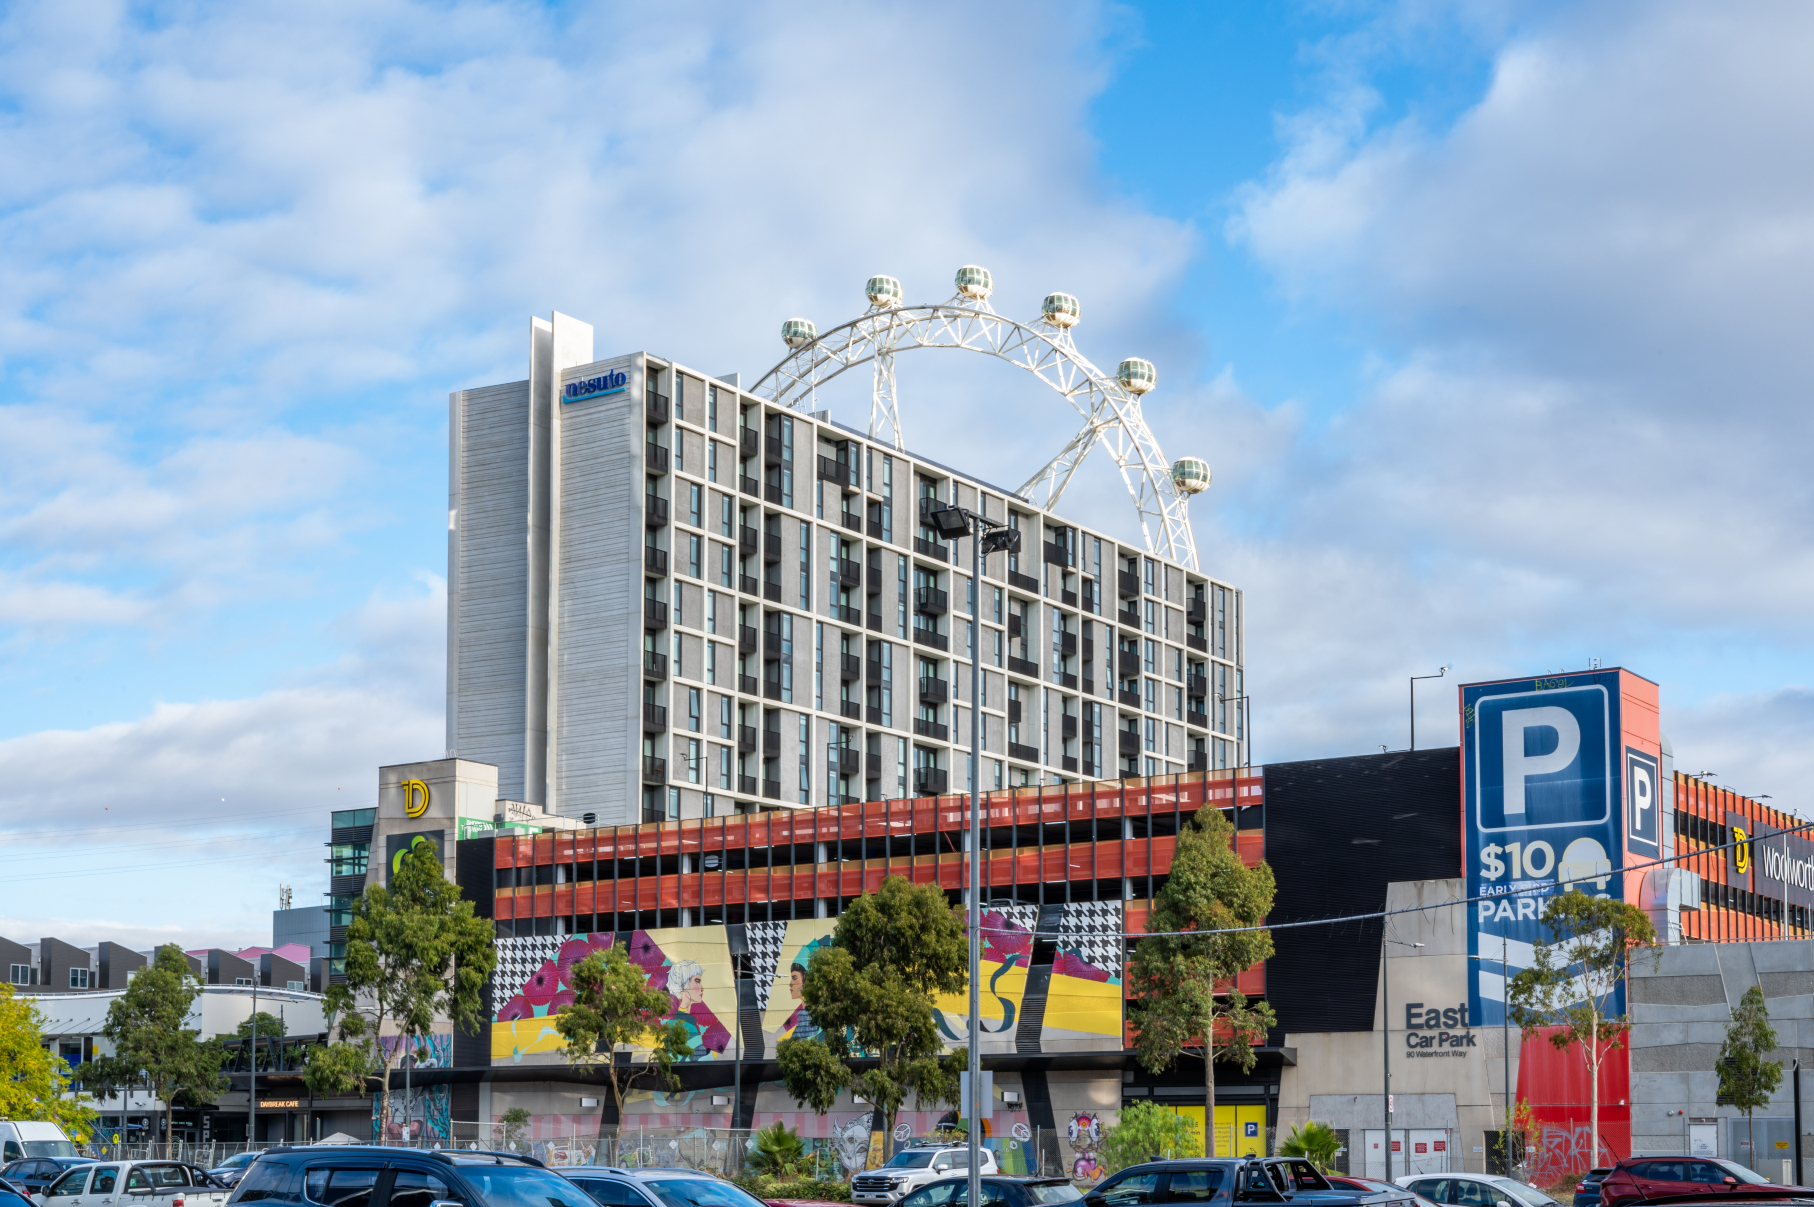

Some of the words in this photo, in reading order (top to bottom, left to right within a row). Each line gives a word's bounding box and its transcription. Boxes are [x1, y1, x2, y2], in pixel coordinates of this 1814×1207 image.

[565, 368, 627, 397] nesuto
[1502, 705, 1581, 815] P
[1633, 765, 1652, 831] P
[1479, 840, 1555, 881] $10
[1479, 884, 1517, 896] EARLY
[1406, 1003, 1469, 1029] East
[1406, 1032, 1436, 1049] Car
[1438, 1031, 1477, 1048] Park
[1406, 1050, 1415, 1058] 90
[1415, 1049, 1450, 1058] Waterfront
[1451, 1049, 1467, 1058] Way
[285, 1100, 299, 1108] CAFE
[1247, 1124, 1256, 1135] P
